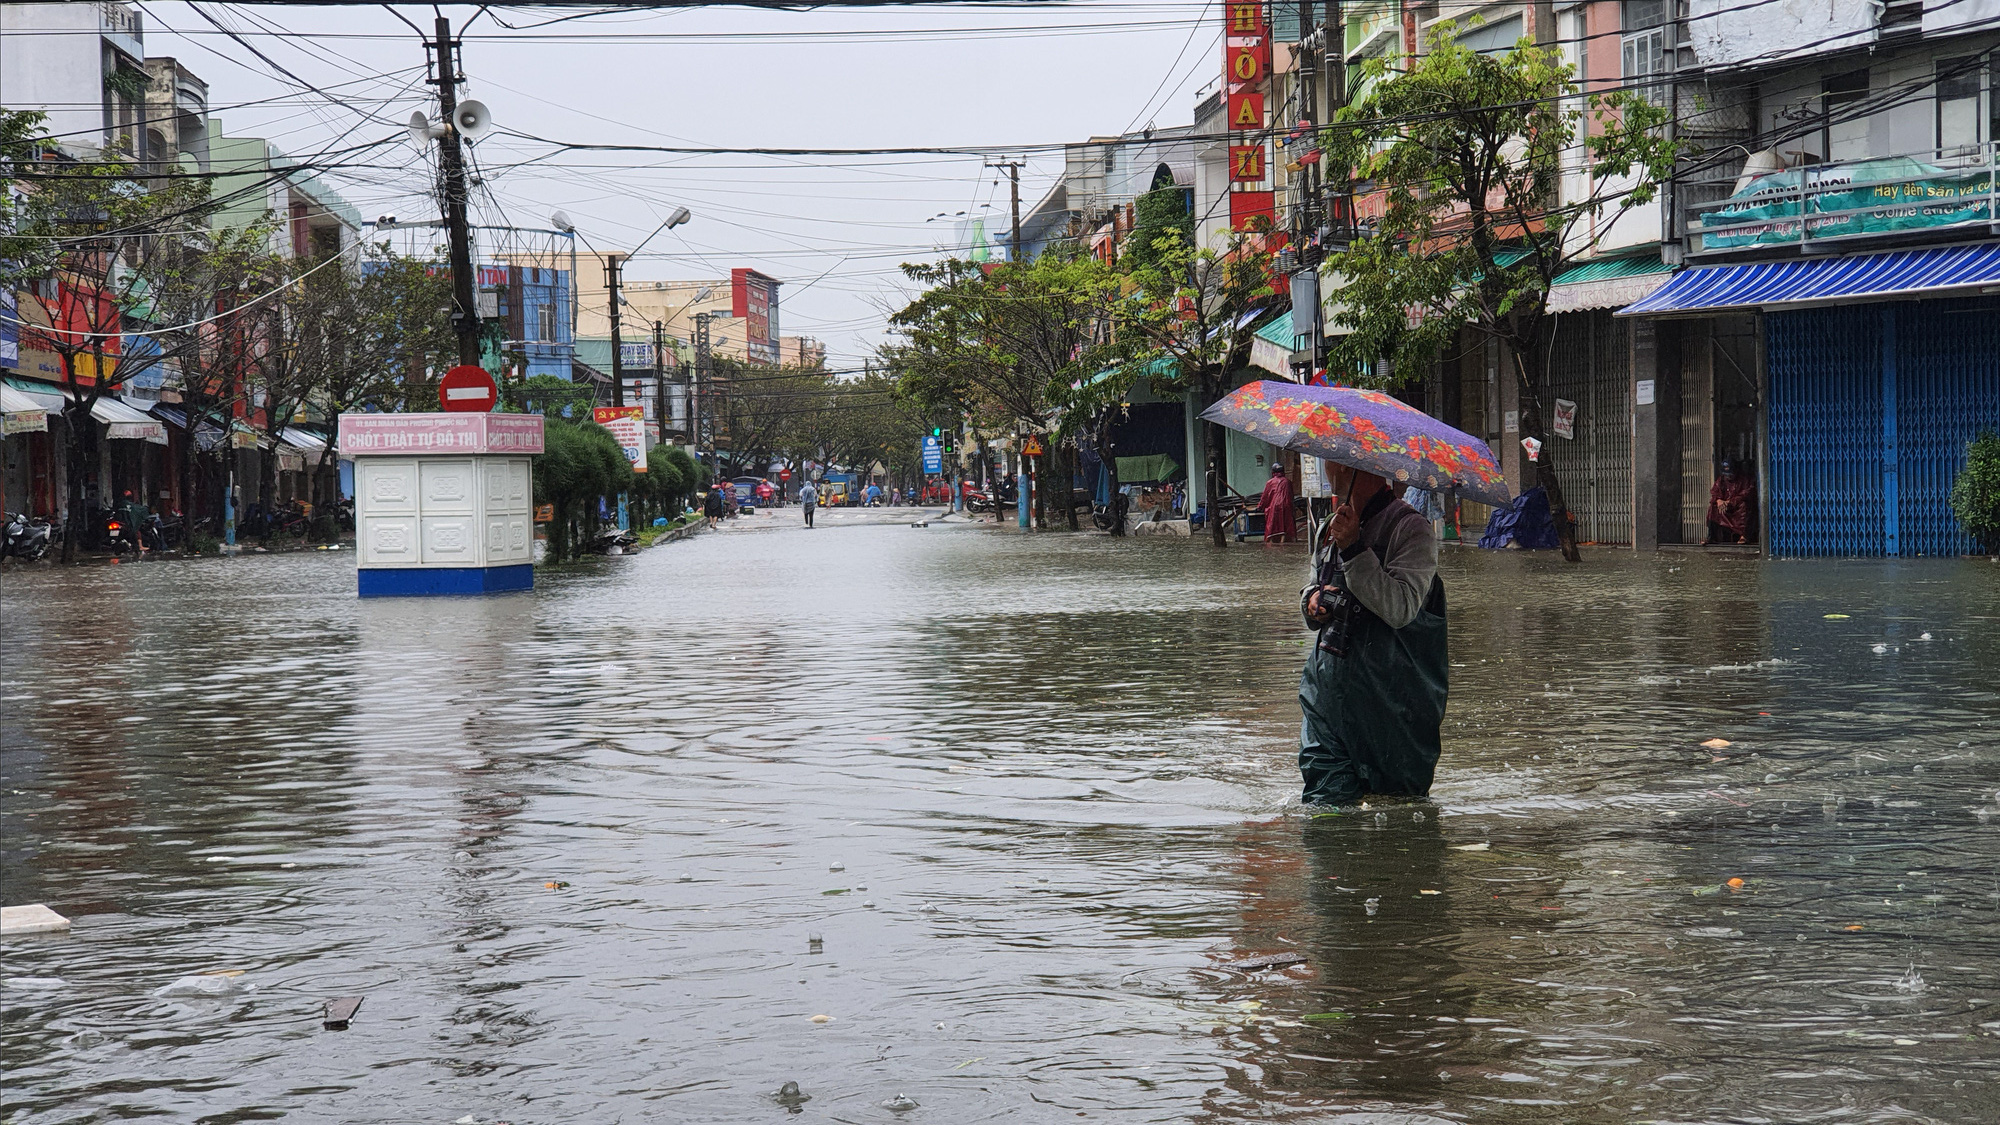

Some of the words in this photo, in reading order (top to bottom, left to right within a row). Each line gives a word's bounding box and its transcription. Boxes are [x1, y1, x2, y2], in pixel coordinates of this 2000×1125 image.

[347, 429, 380, 447] CHỐT
[383, 430, 414, 449] TRẬT
[417, 431, 434, 449] TỰ
[436, 430, 453, 446] ĐÔ
[458, 431, 478, 449] THỊ
